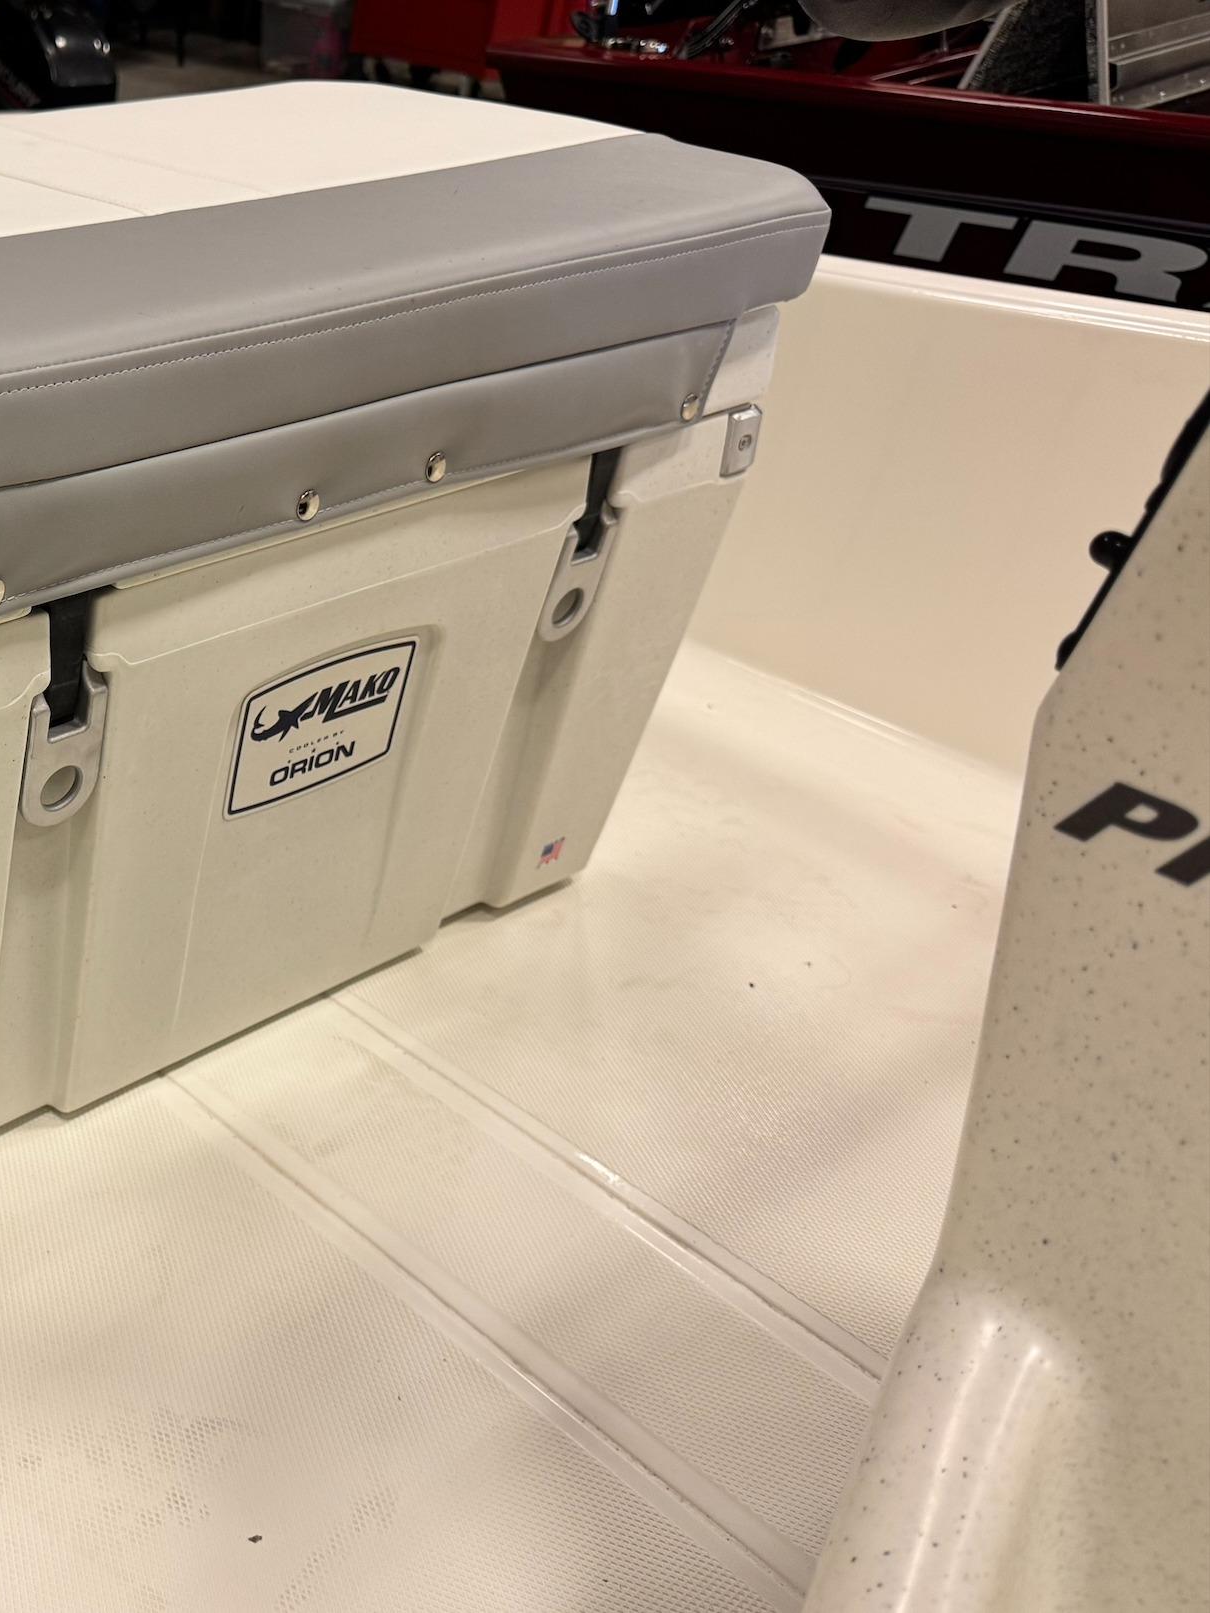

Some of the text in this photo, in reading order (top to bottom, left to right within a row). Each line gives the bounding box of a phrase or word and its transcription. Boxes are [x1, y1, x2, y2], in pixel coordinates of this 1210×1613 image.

[864, 195, 1210, 308] TR
[300, 666, 400, 724] MAKO
[269, 740, 356, 787] ORION
